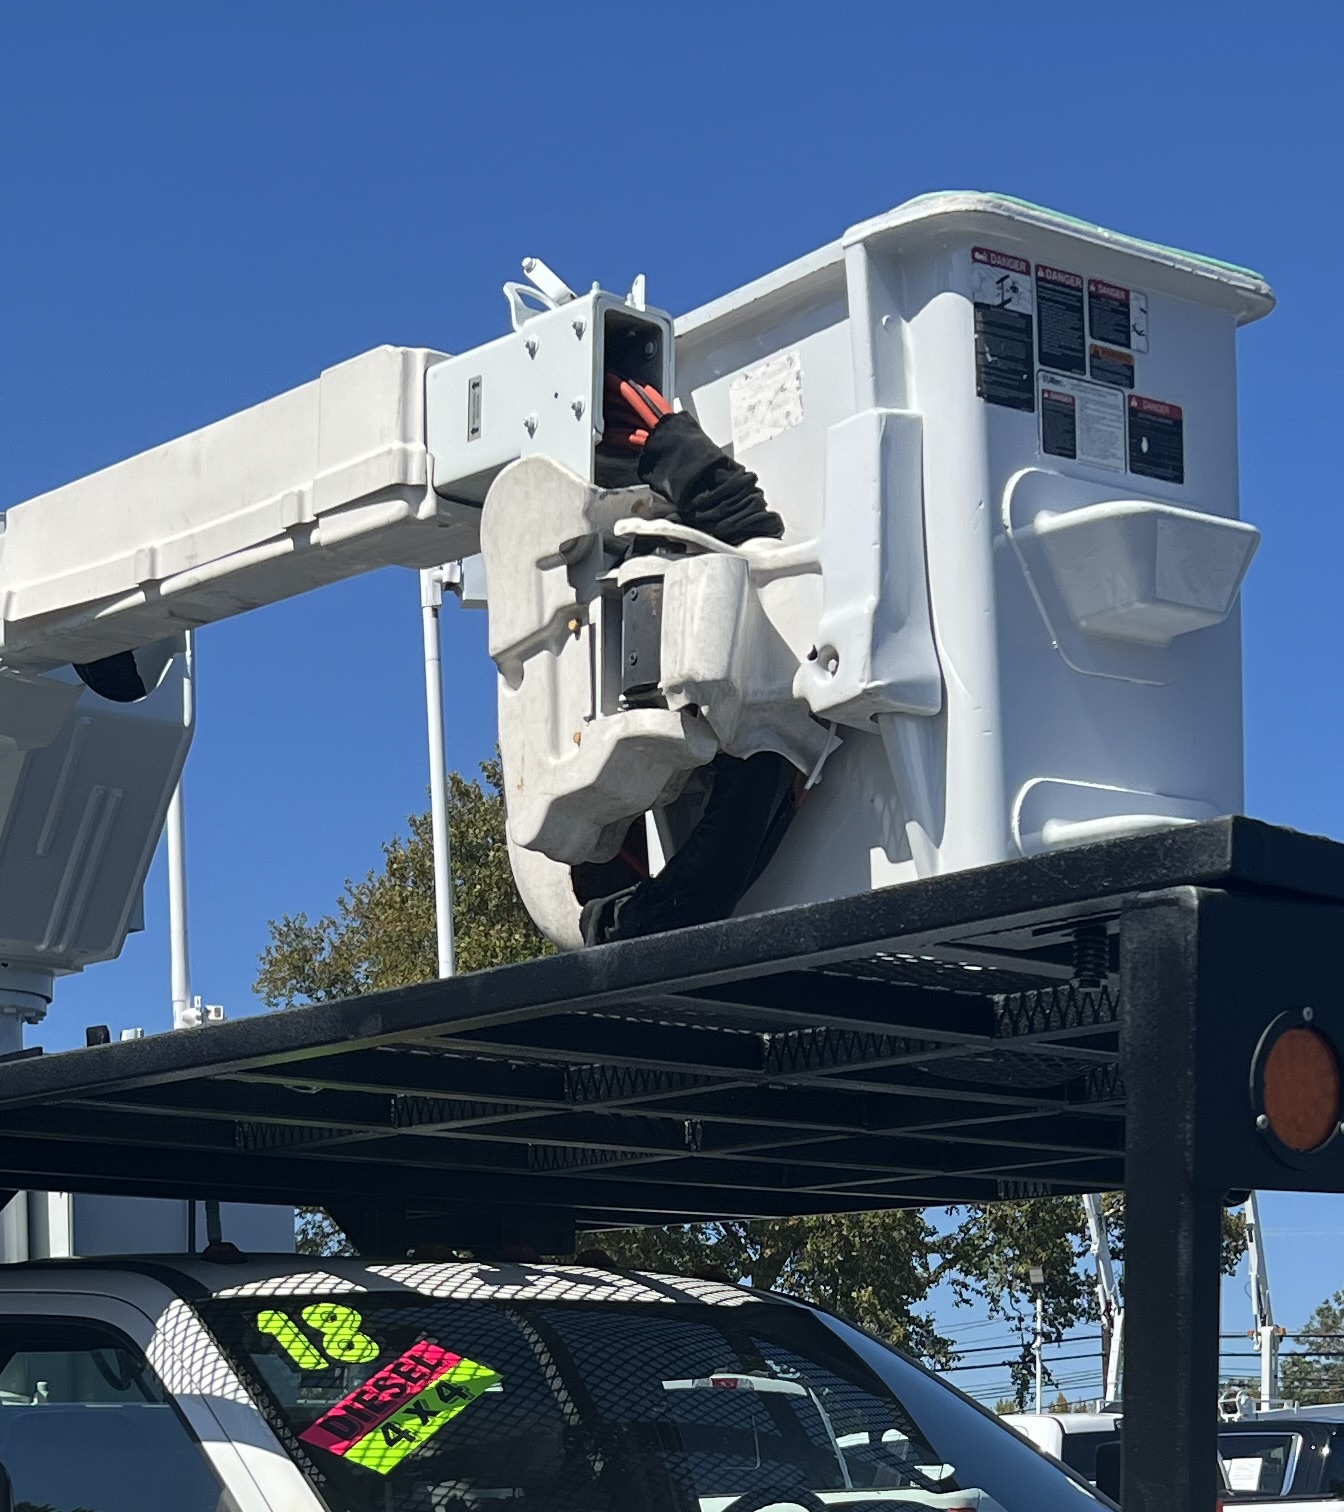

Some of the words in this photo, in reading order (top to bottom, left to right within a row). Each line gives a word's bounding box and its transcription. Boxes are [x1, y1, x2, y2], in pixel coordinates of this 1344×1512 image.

[990, 252, 1026, 273] DANGER
[1045, 268, 1083, 289] DANGER
[257, 1302, 380, 1370] 18
[319, 1354, 444, 1441] DIESEL
